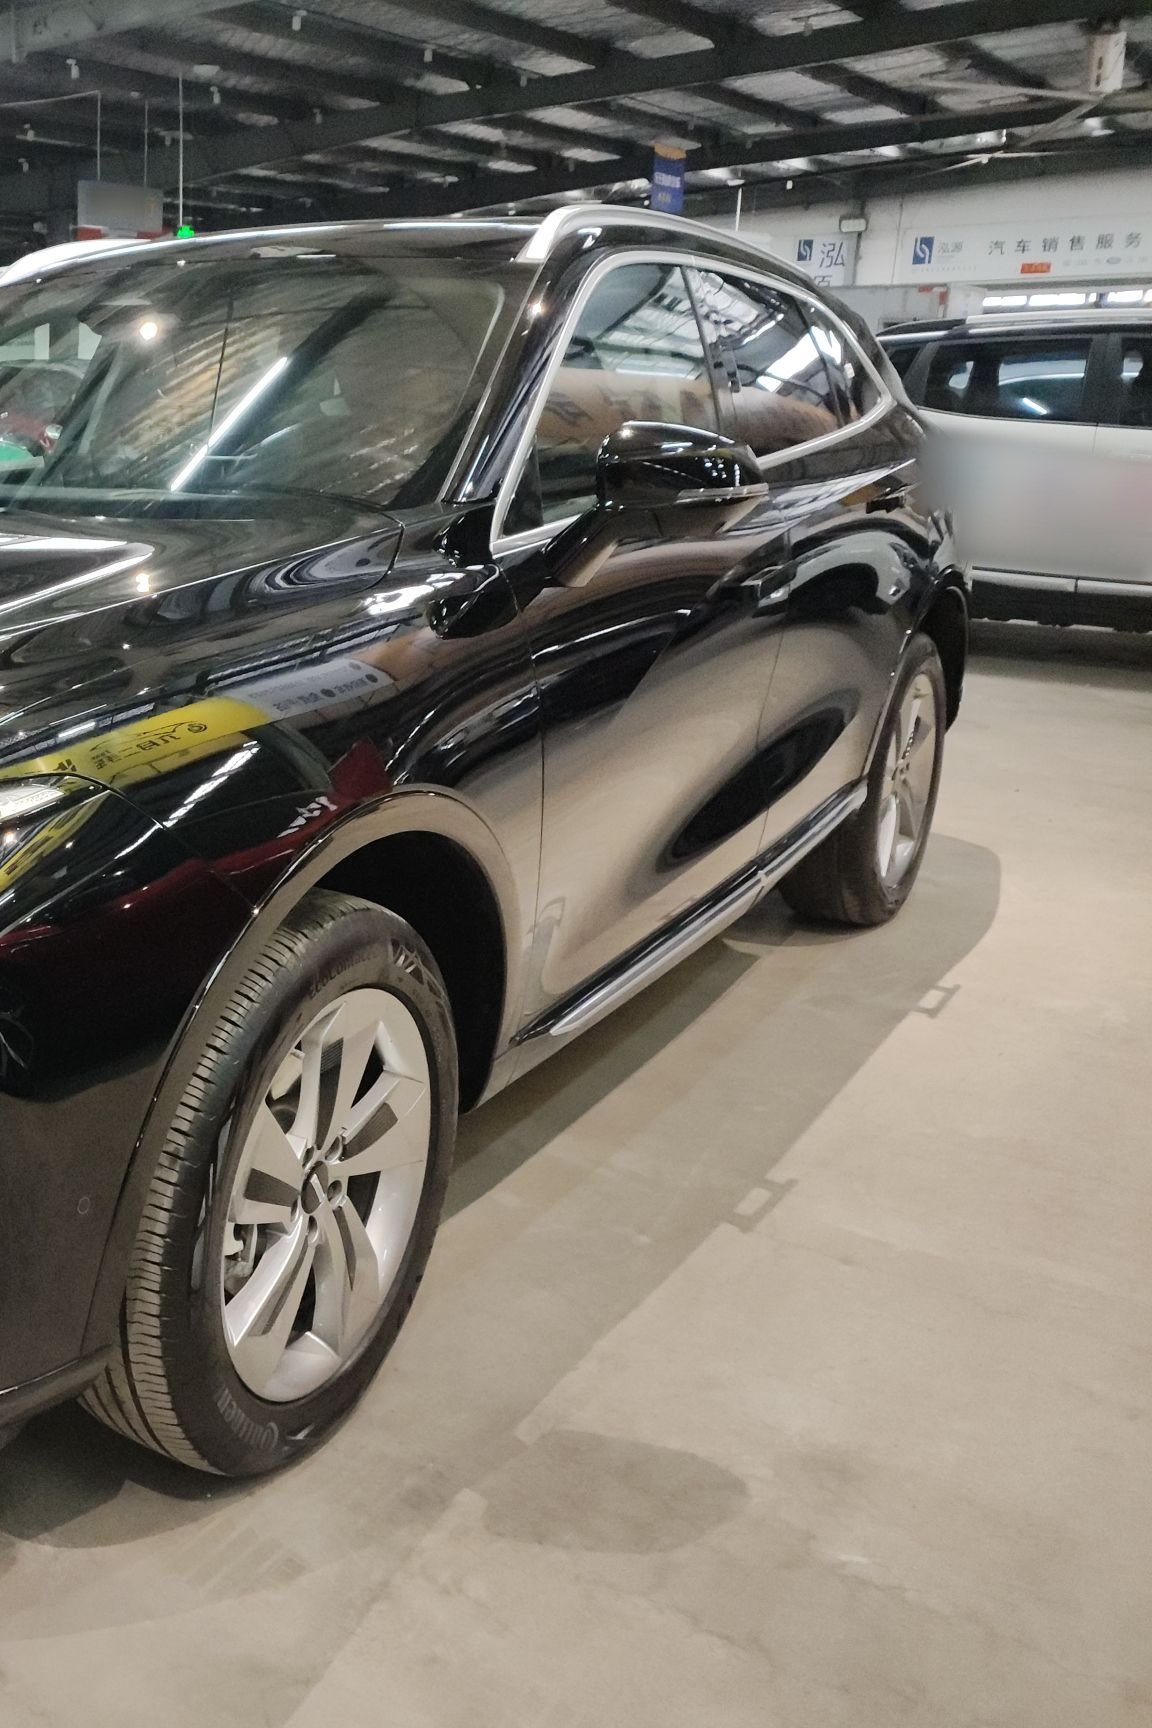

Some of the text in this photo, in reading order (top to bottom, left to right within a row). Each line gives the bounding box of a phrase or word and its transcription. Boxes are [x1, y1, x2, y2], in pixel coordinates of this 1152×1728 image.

[988, 231, 1143, 256] 汽车销售服务
